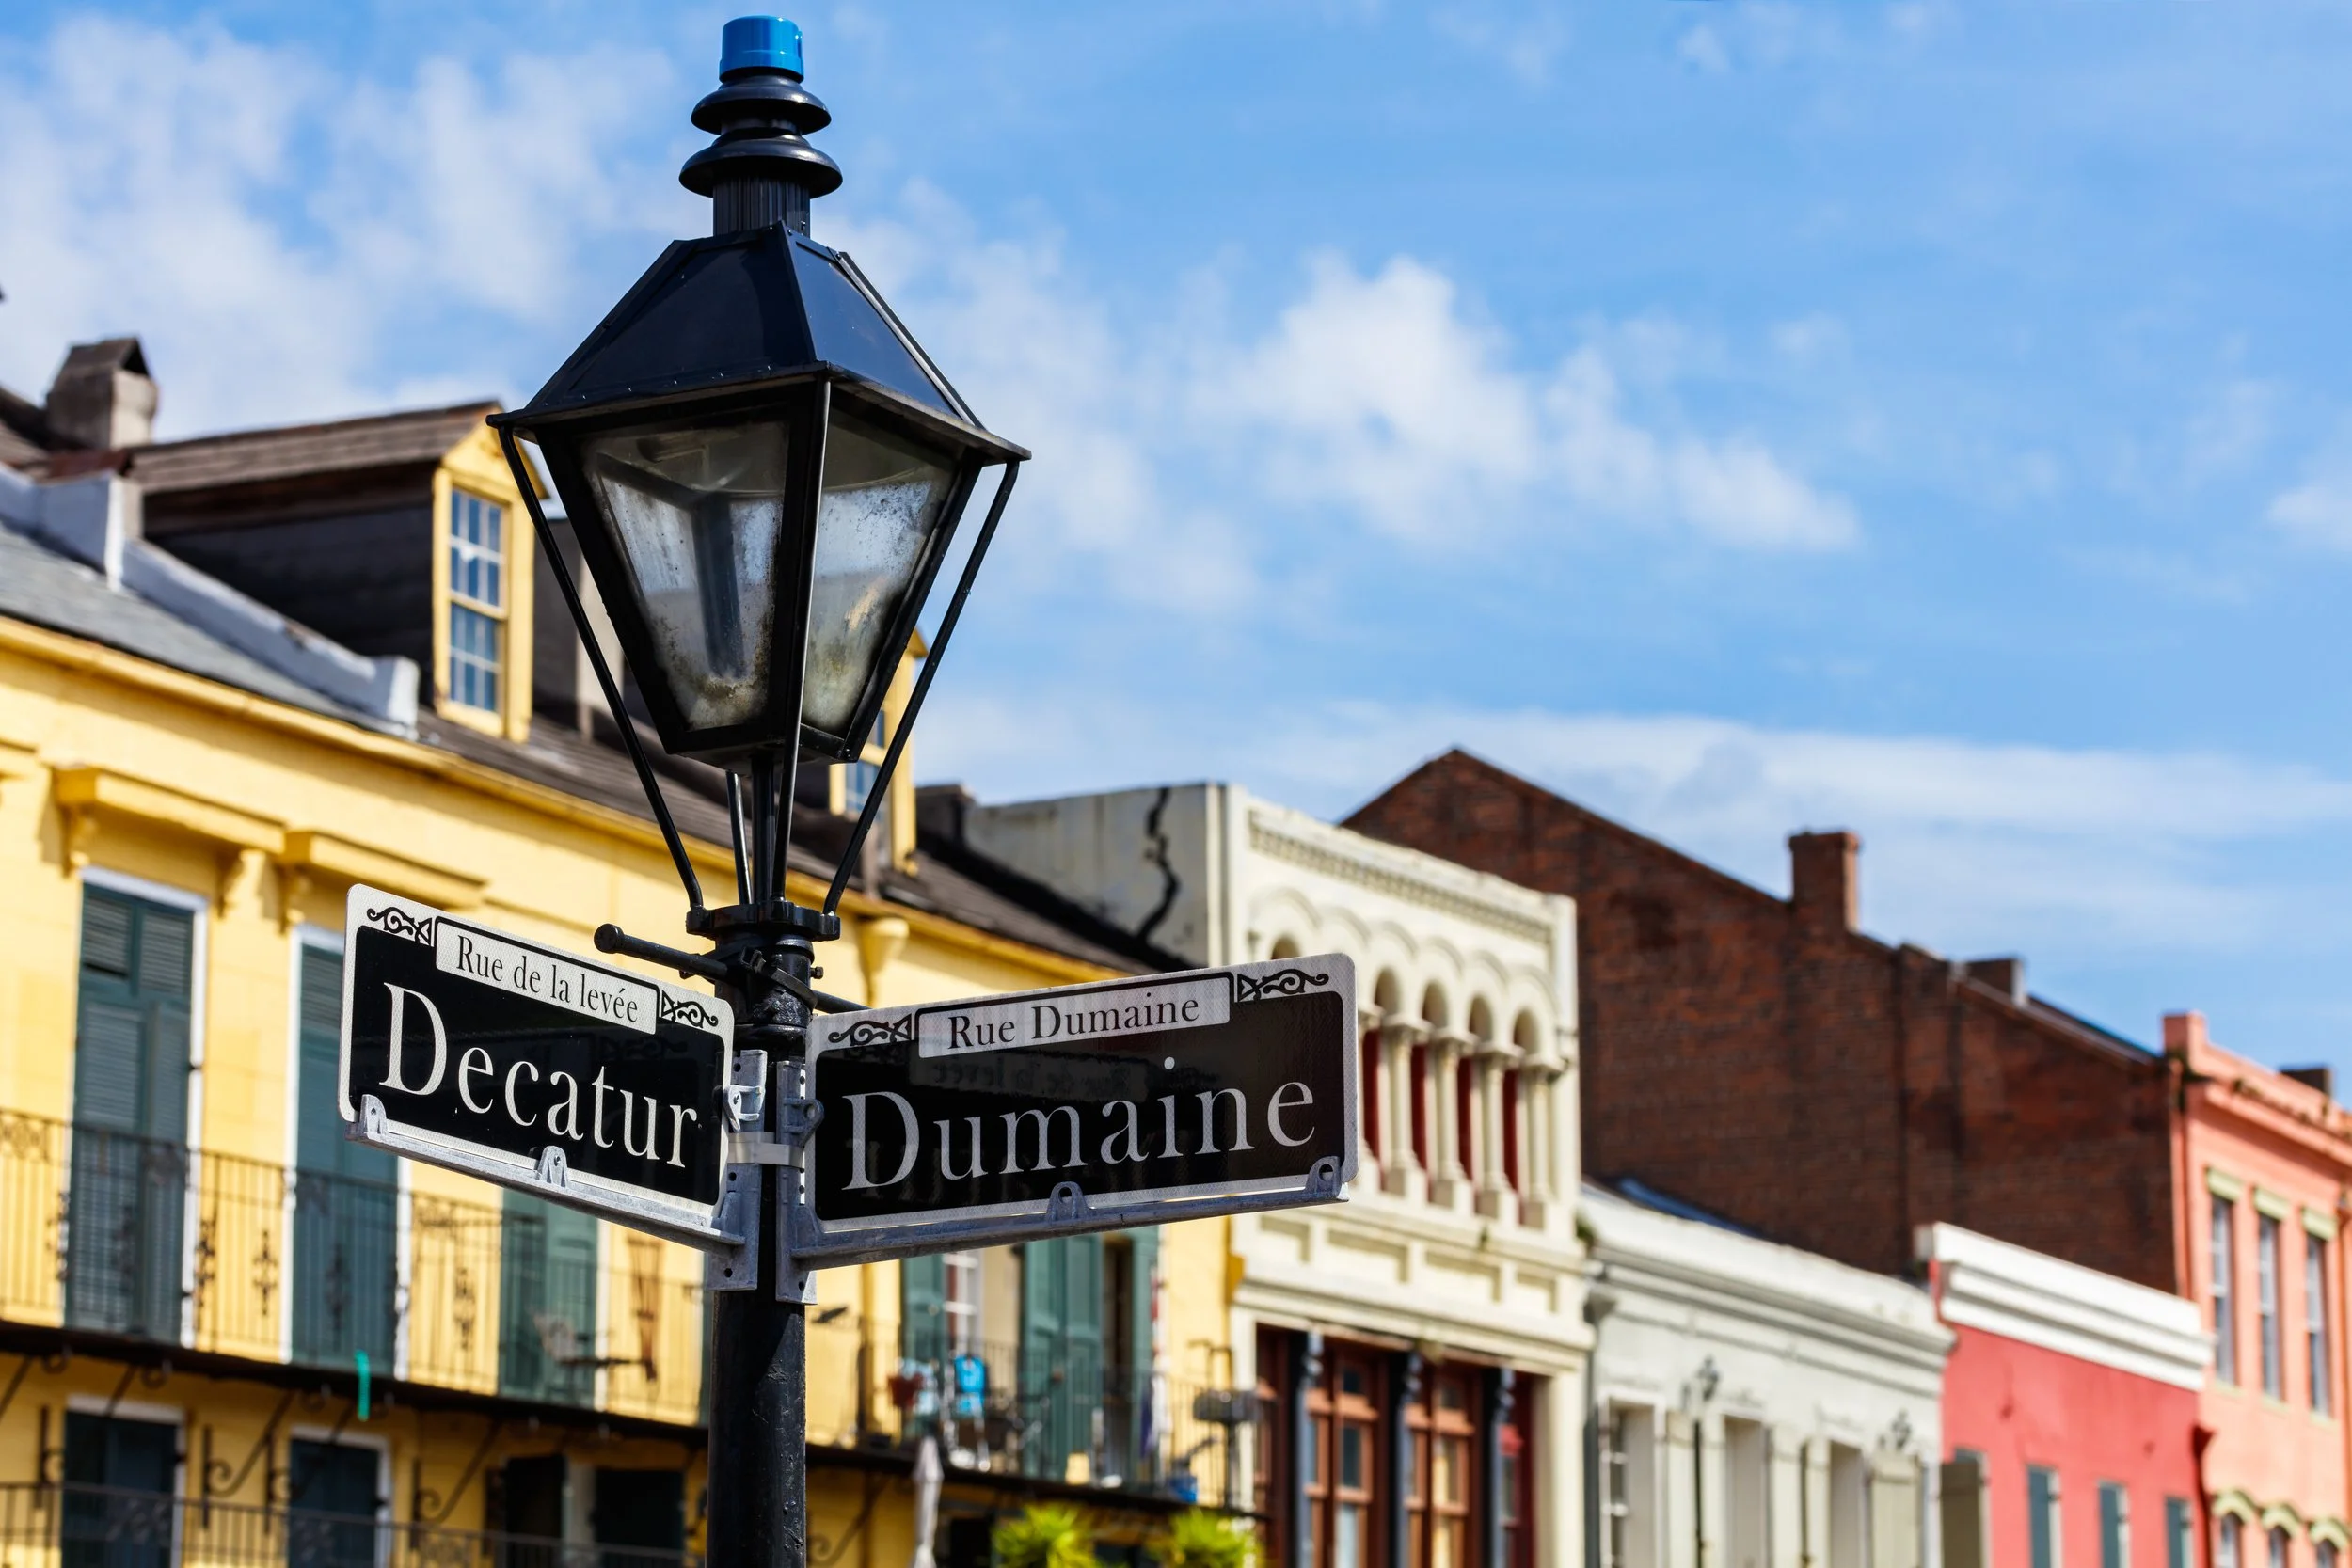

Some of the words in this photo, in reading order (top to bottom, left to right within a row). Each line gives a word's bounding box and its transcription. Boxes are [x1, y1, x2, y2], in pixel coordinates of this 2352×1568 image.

[456, 935, 503, 981] Rue
[514, 956, 541, 993] de
[550, 965, 570, 1004] la
[580, 974, 638, 1022] levée
[947, 1015, 1016, 1050] Rue
[1031, 992, 1200, 1039] Dumaine
[378, 982, 698, 1168] Decatur
[841, 1056, 1315, 1190] Dumaine
